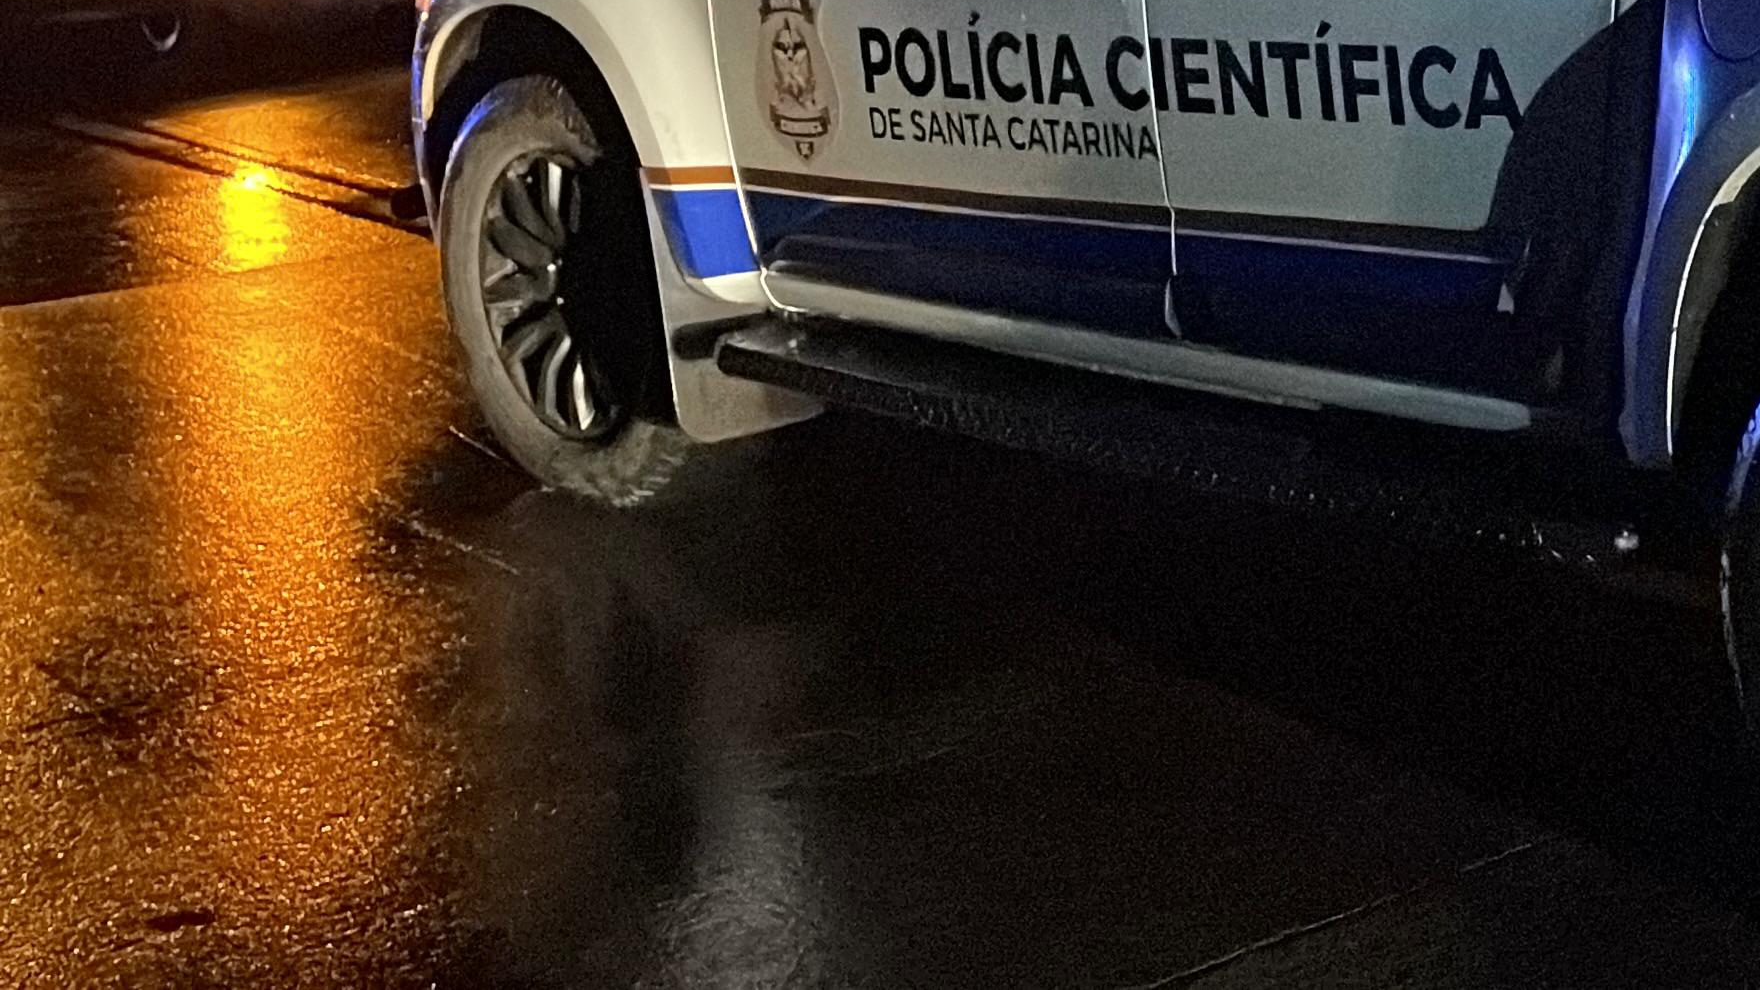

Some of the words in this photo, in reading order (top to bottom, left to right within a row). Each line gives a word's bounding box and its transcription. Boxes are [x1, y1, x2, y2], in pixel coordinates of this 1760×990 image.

[858, 11, 1094, 107] POLÍCIA
[1106, 20, 1524, 132] CIENTÍFICA
[869, 107, 905, 141] DE
[910, 110, 1002, 149] SANTA
[1008, 117, 1160, 160] CATARINA
